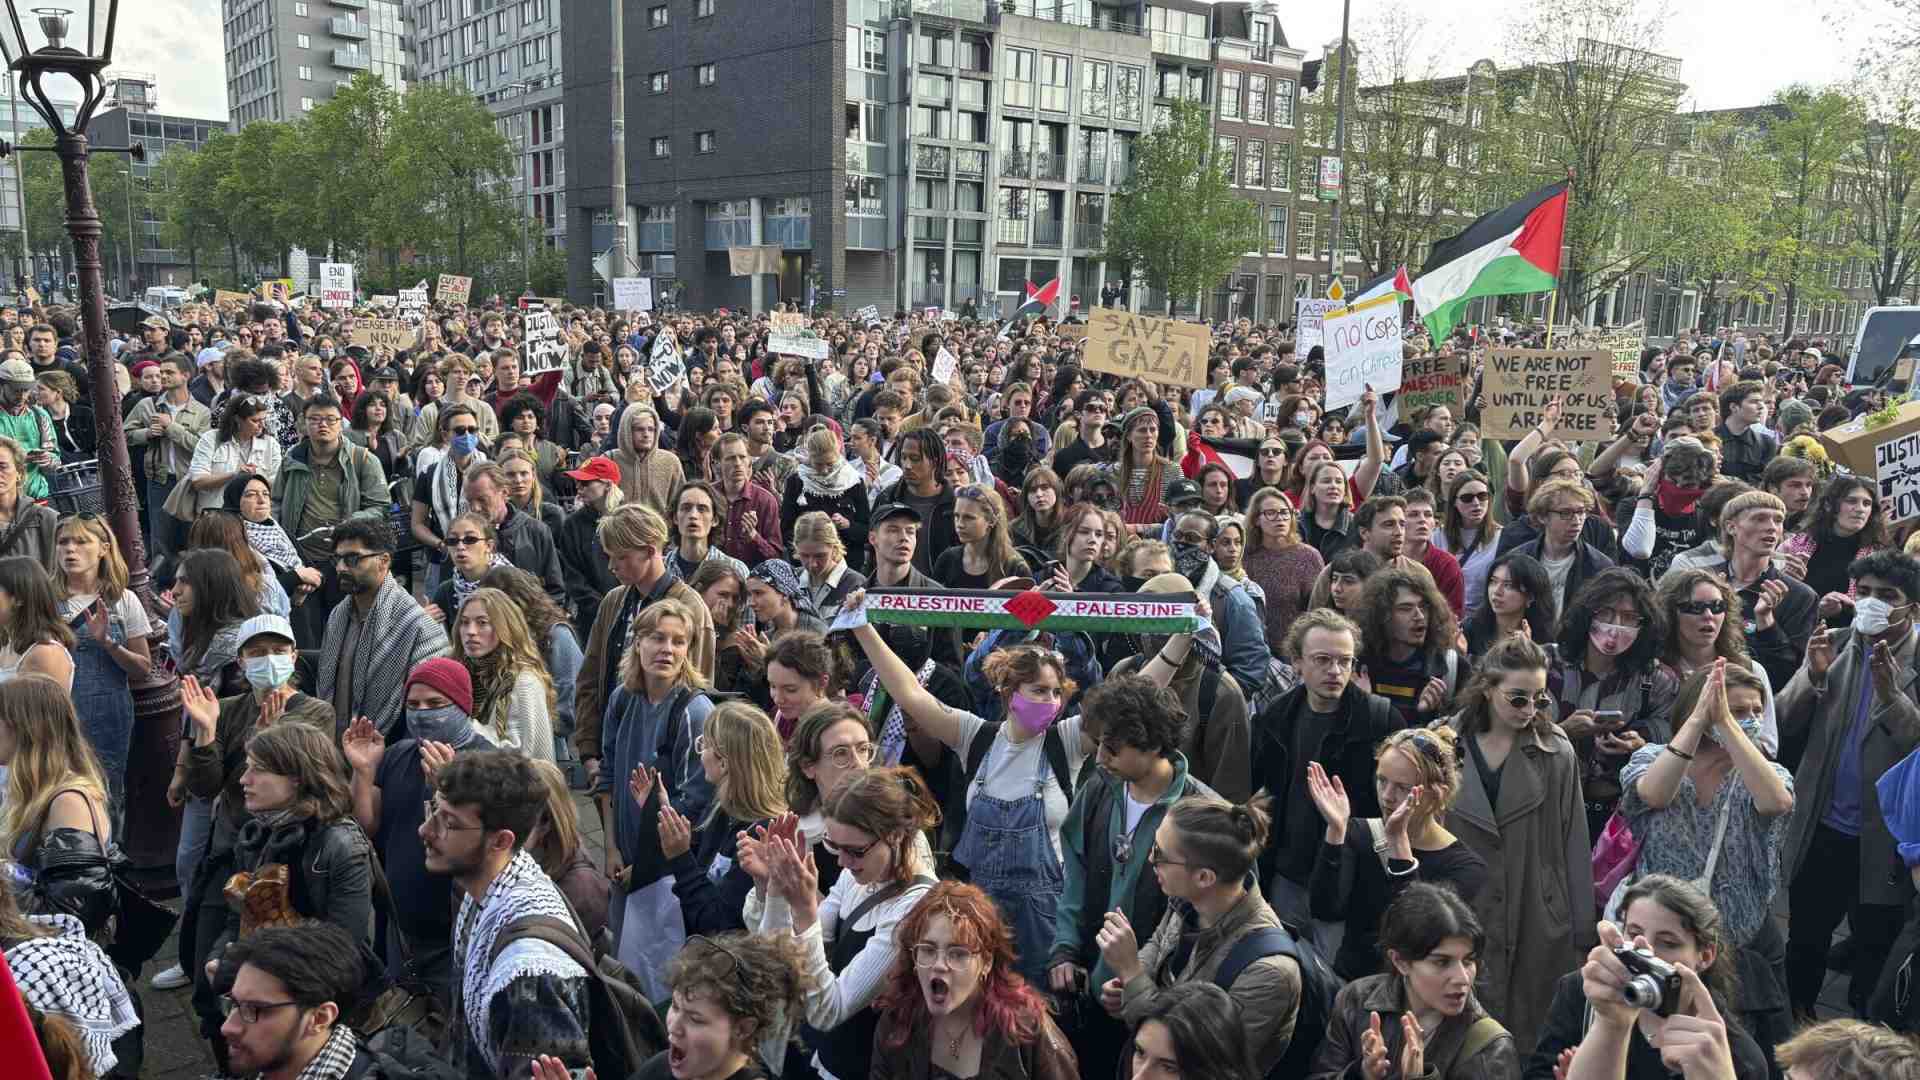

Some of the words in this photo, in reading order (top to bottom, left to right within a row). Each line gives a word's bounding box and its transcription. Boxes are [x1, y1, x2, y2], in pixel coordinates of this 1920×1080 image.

[328, 266, 345, 277] END
[329, 278, 345, 288] THE
[370, 332, 400, 345] NOW
[1104, 314, 1174, 346] SAVE
[529, 350, 567, 371] NOW
[1108, 340, 1193, 382] GAZA
[1402, 358, 1447, 379] FREE
[1492, 355, 1521, 373] WE
[1523, 356, 1554, 373] ARE
[1555, 355, 1593, 373] NOT
[1525, 374, 1571, 391] FREE
[1493, 391, 1538, 407] UNTIL
[1566, 392, 1585, 407] OF
[881, 594, 985, 612] PALESTINE
[1076, 601, 1184, 616] PALESTINE
